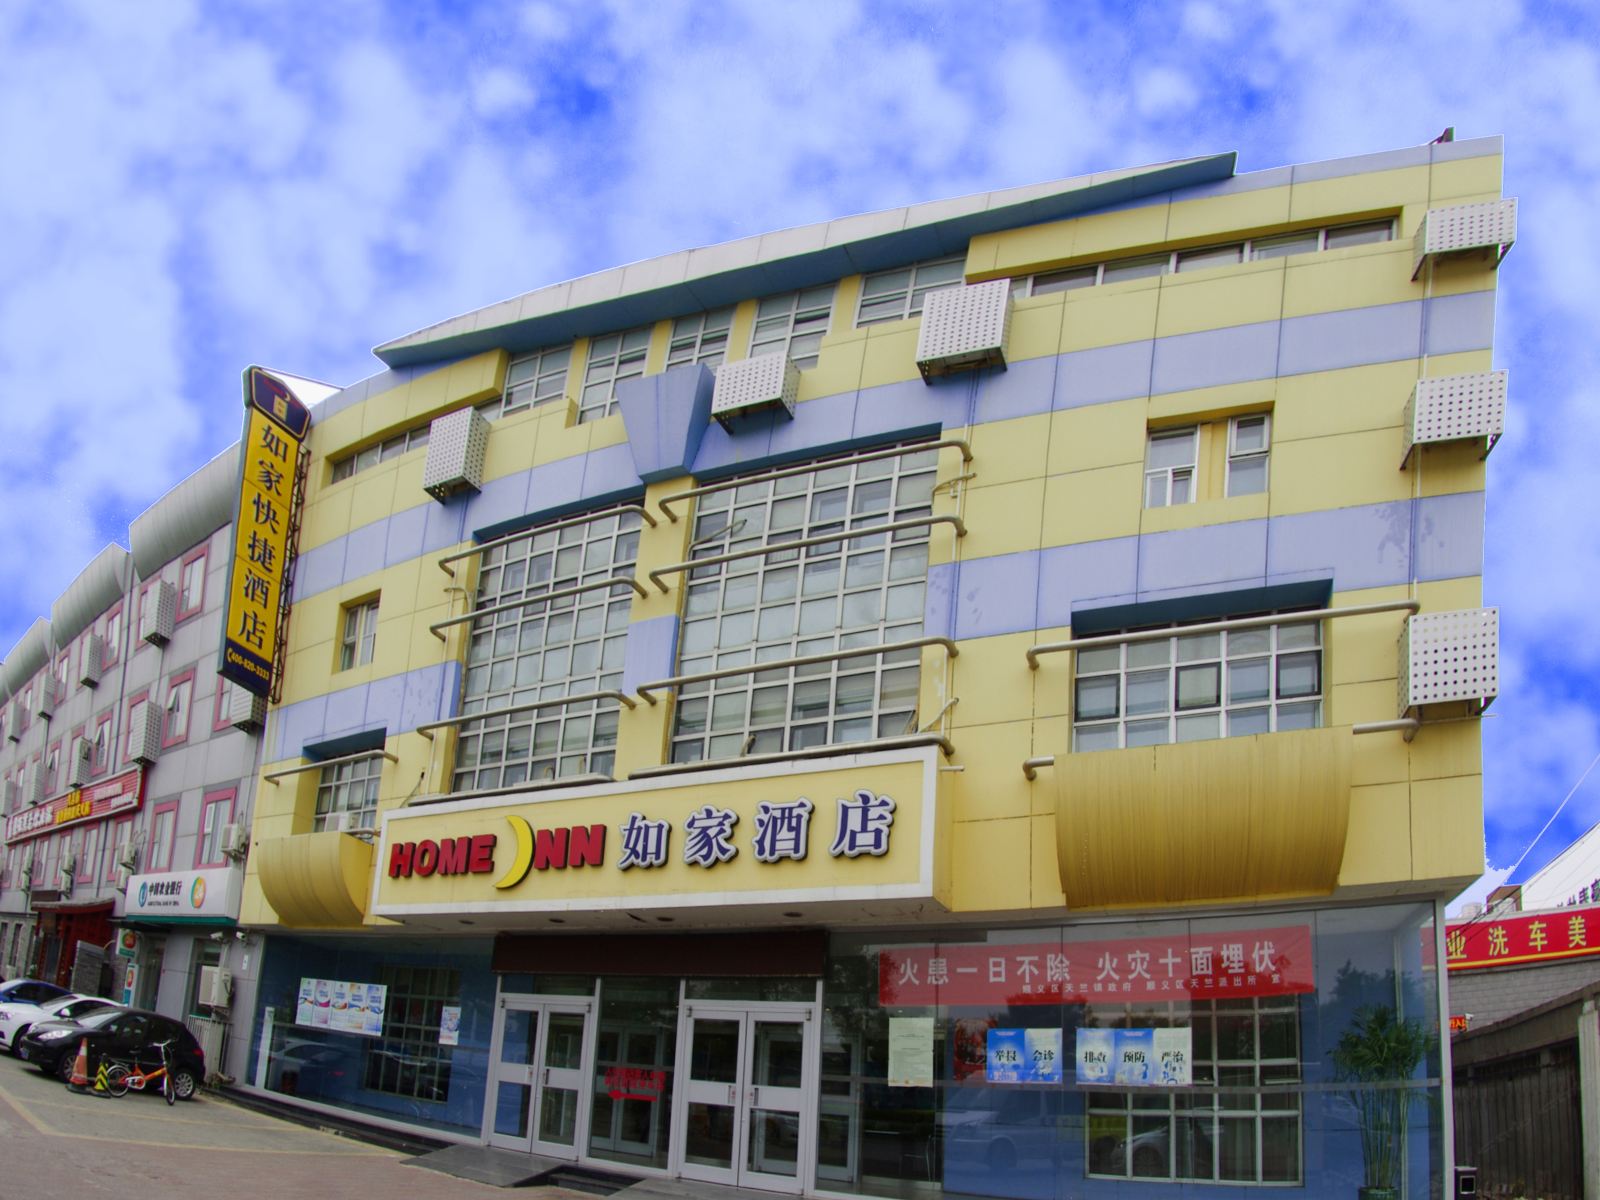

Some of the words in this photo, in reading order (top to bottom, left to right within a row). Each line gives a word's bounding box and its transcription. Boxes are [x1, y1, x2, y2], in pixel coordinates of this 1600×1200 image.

[238, 423, 288, 650] 如家快捷酒店
[617, 788, 896, 871] 如家酒店
[388, 833, 497, 878] HOME
[898, 953, 1070, 986] 火患一日不除
[1096, 941, 1277, 982] 火灾十面埋伏
[1123, 1050, 1145, 1063] 预防
